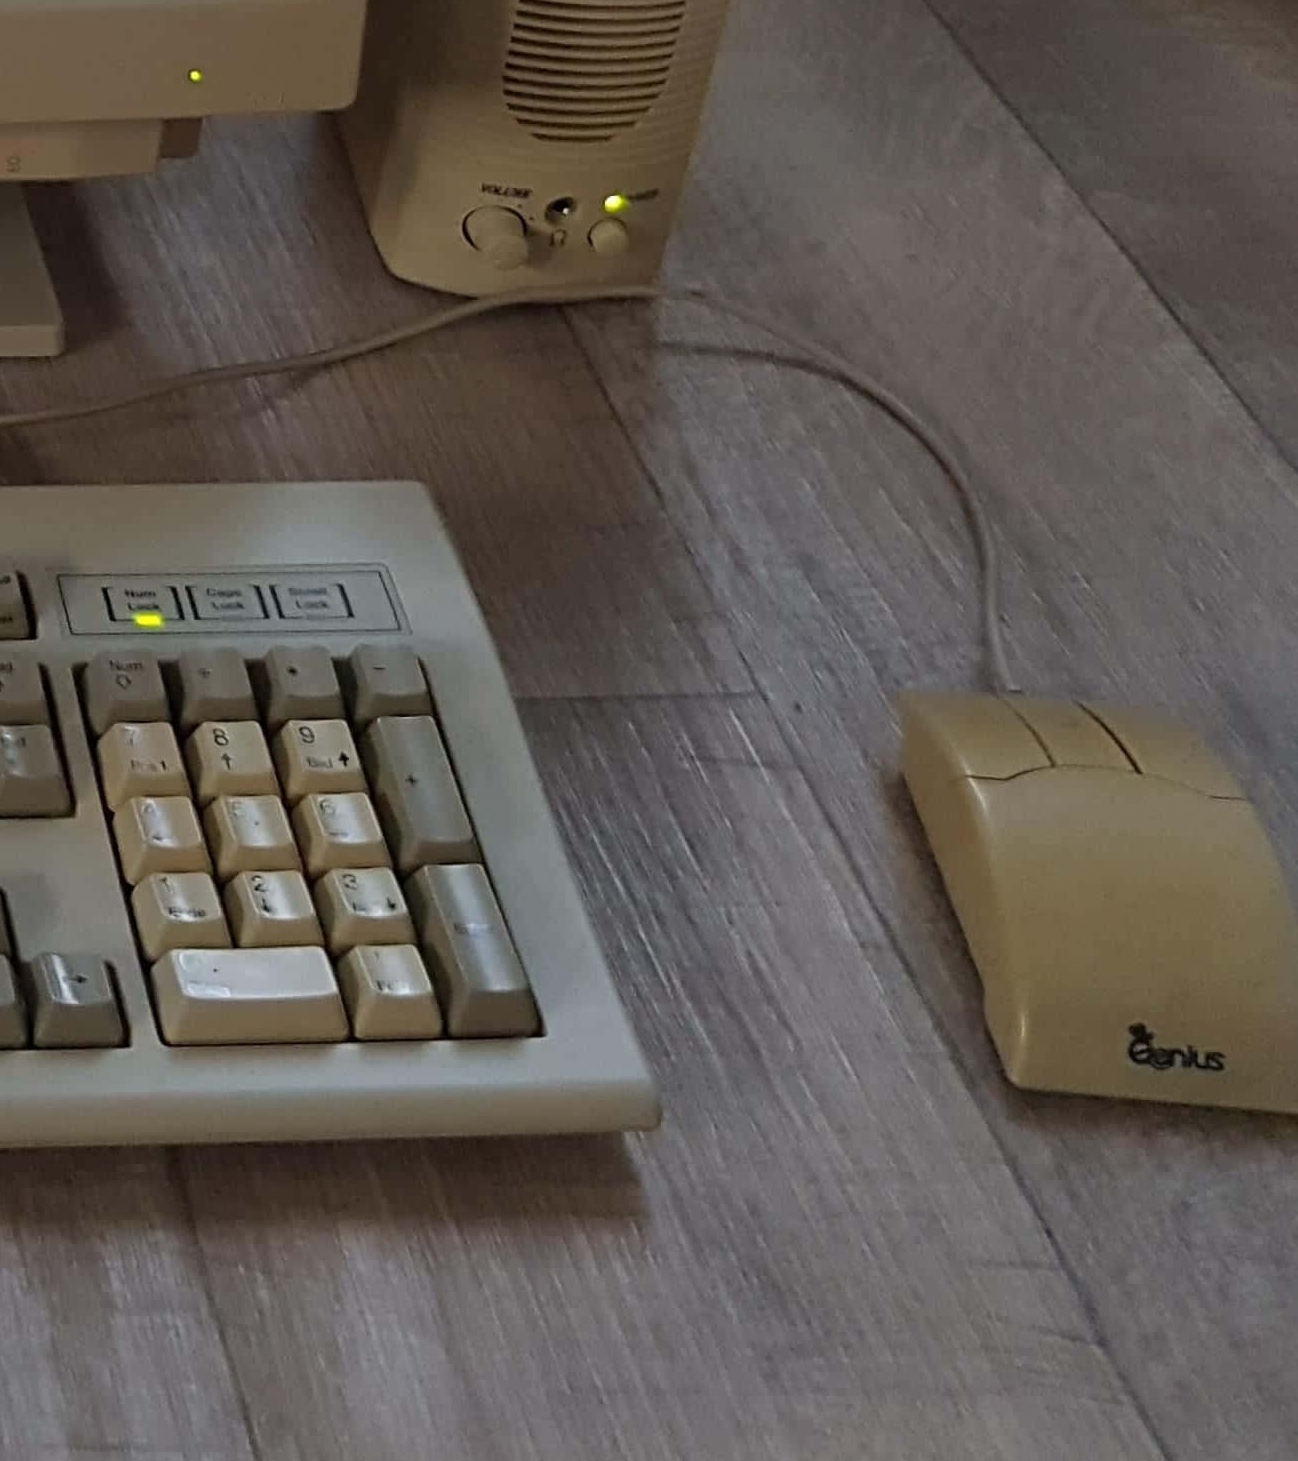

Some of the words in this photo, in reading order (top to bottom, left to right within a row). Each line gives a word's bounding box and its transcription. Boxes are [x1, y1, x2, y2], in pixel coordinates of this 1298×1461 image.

[109, 660, 143, 671] Num
[212, 727, 229, 746] 8
[299, 726, 315, 744] 9
[319, 797, 335, 815] 6
[251, 875, 266, 893] 2
[342, 874, 357, 890] 3
